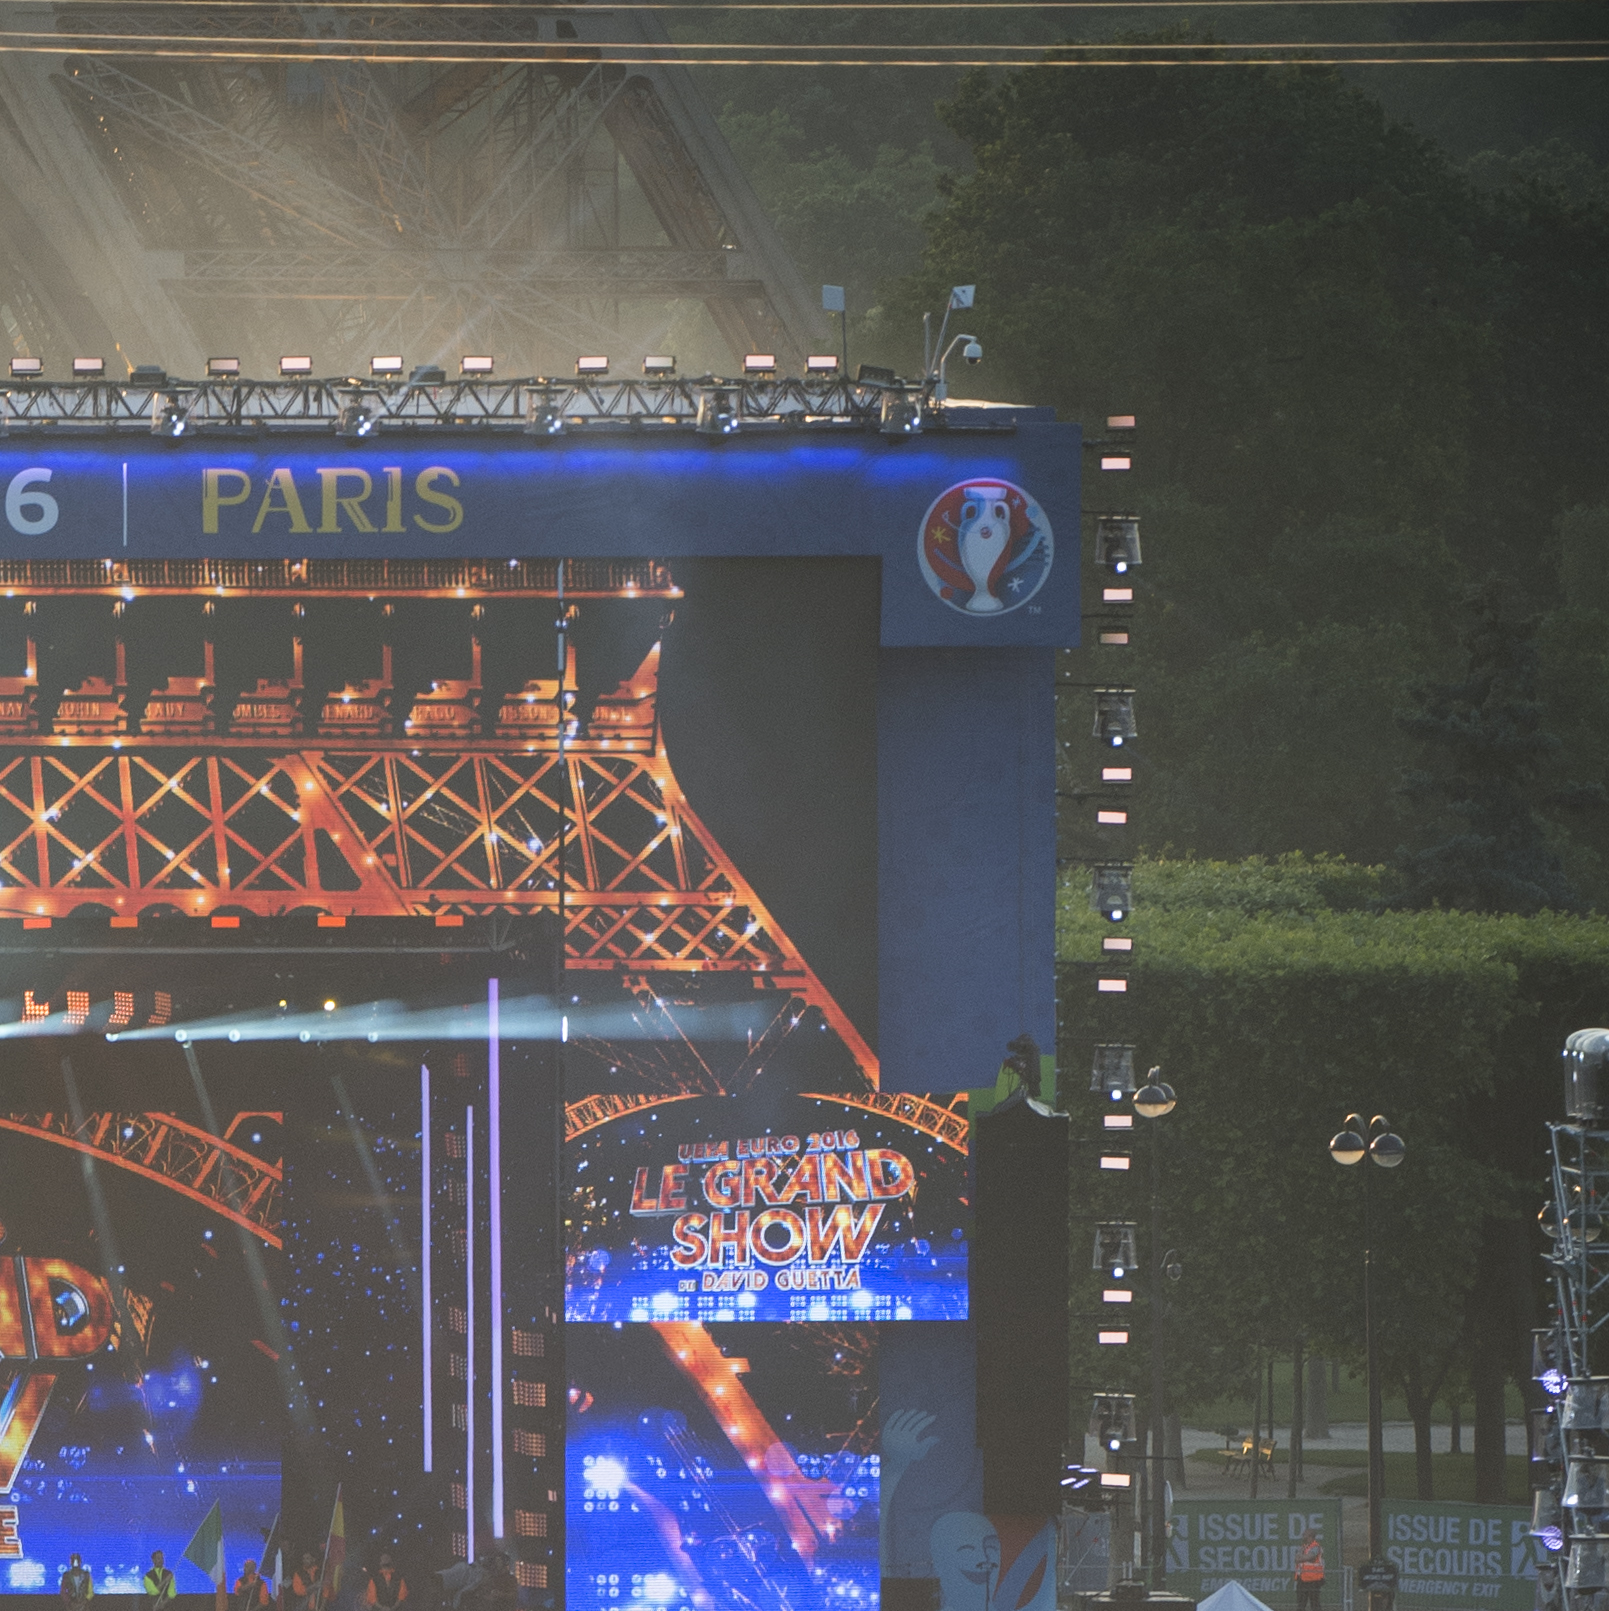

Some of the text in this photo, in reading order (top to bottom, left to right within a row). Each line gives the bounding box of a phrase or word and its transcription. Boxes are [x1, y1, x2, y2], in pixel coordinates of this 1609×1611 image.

[202, 466, 464, 534] PARIS
[678, 1129, 860, 1163] UEFA EURO 2016
[629, 1149, 915, 1215] LE GRAND
[670, 1203, 886, 1267] SHOW
[702, 1270, 769, 1292] DAVID
[775, 1268, 862, 1291] GUETTA
[1198, 1512, 1324, 1541] ISSUE DE
[1387, 1513, 1503, 1547] ISSUE DE
[1386, 1546, 1502, 1578] SECOURS
[1397, 1577, 1502, 1598] MERGENCY EXIT
